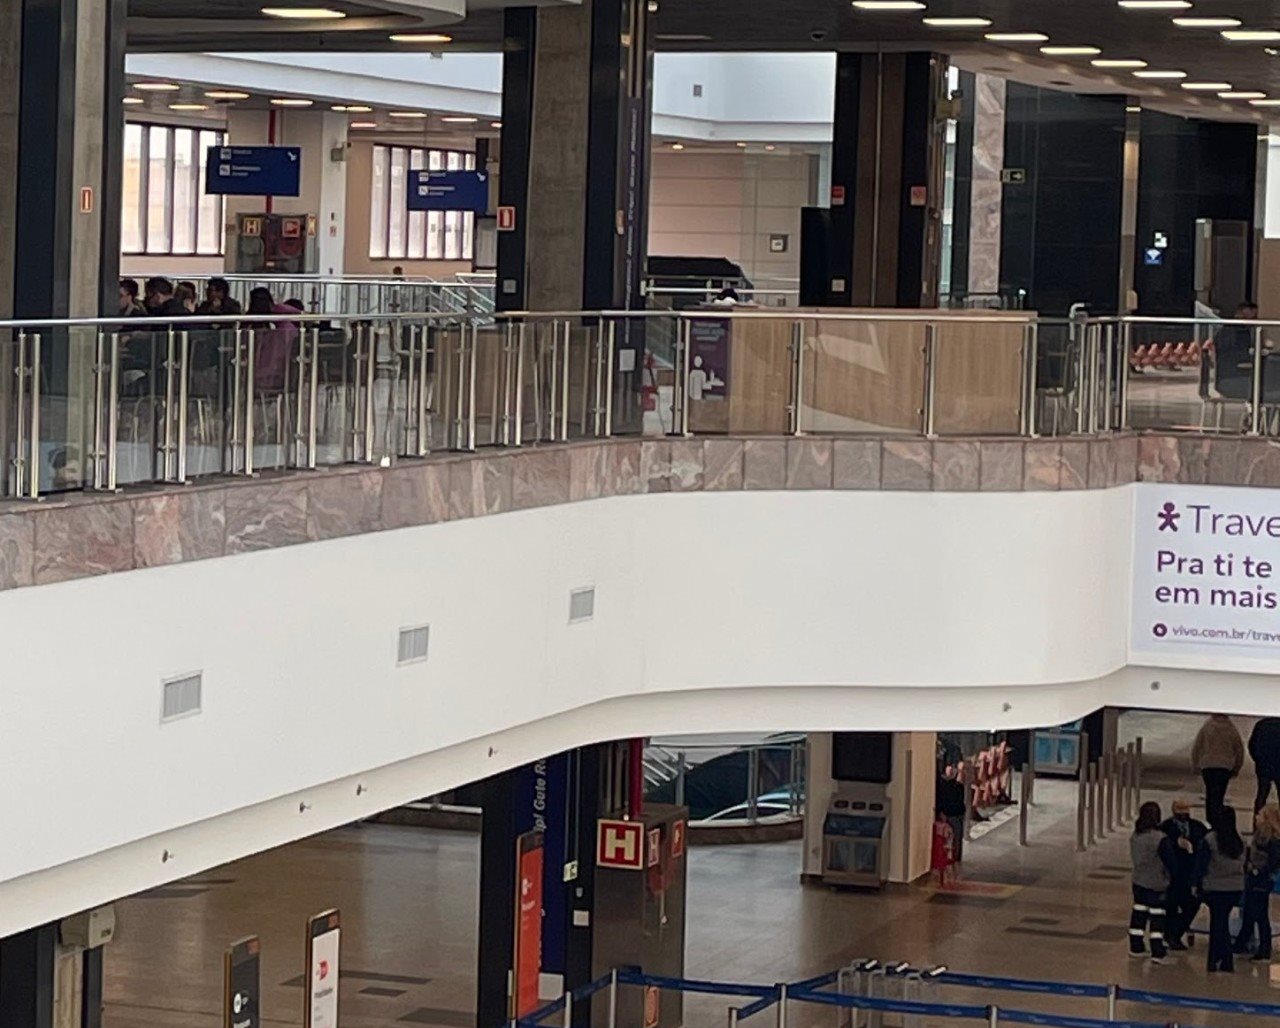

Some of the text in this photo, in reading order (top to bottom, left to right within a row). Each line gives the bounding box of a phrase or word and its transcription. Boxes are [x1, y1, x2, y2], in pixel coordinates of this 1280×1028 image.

[1157, 549, 1273, 579] Pra ti te
[1154, 584, 1278, 610] em mais
[604, 828, 636, 861] H
